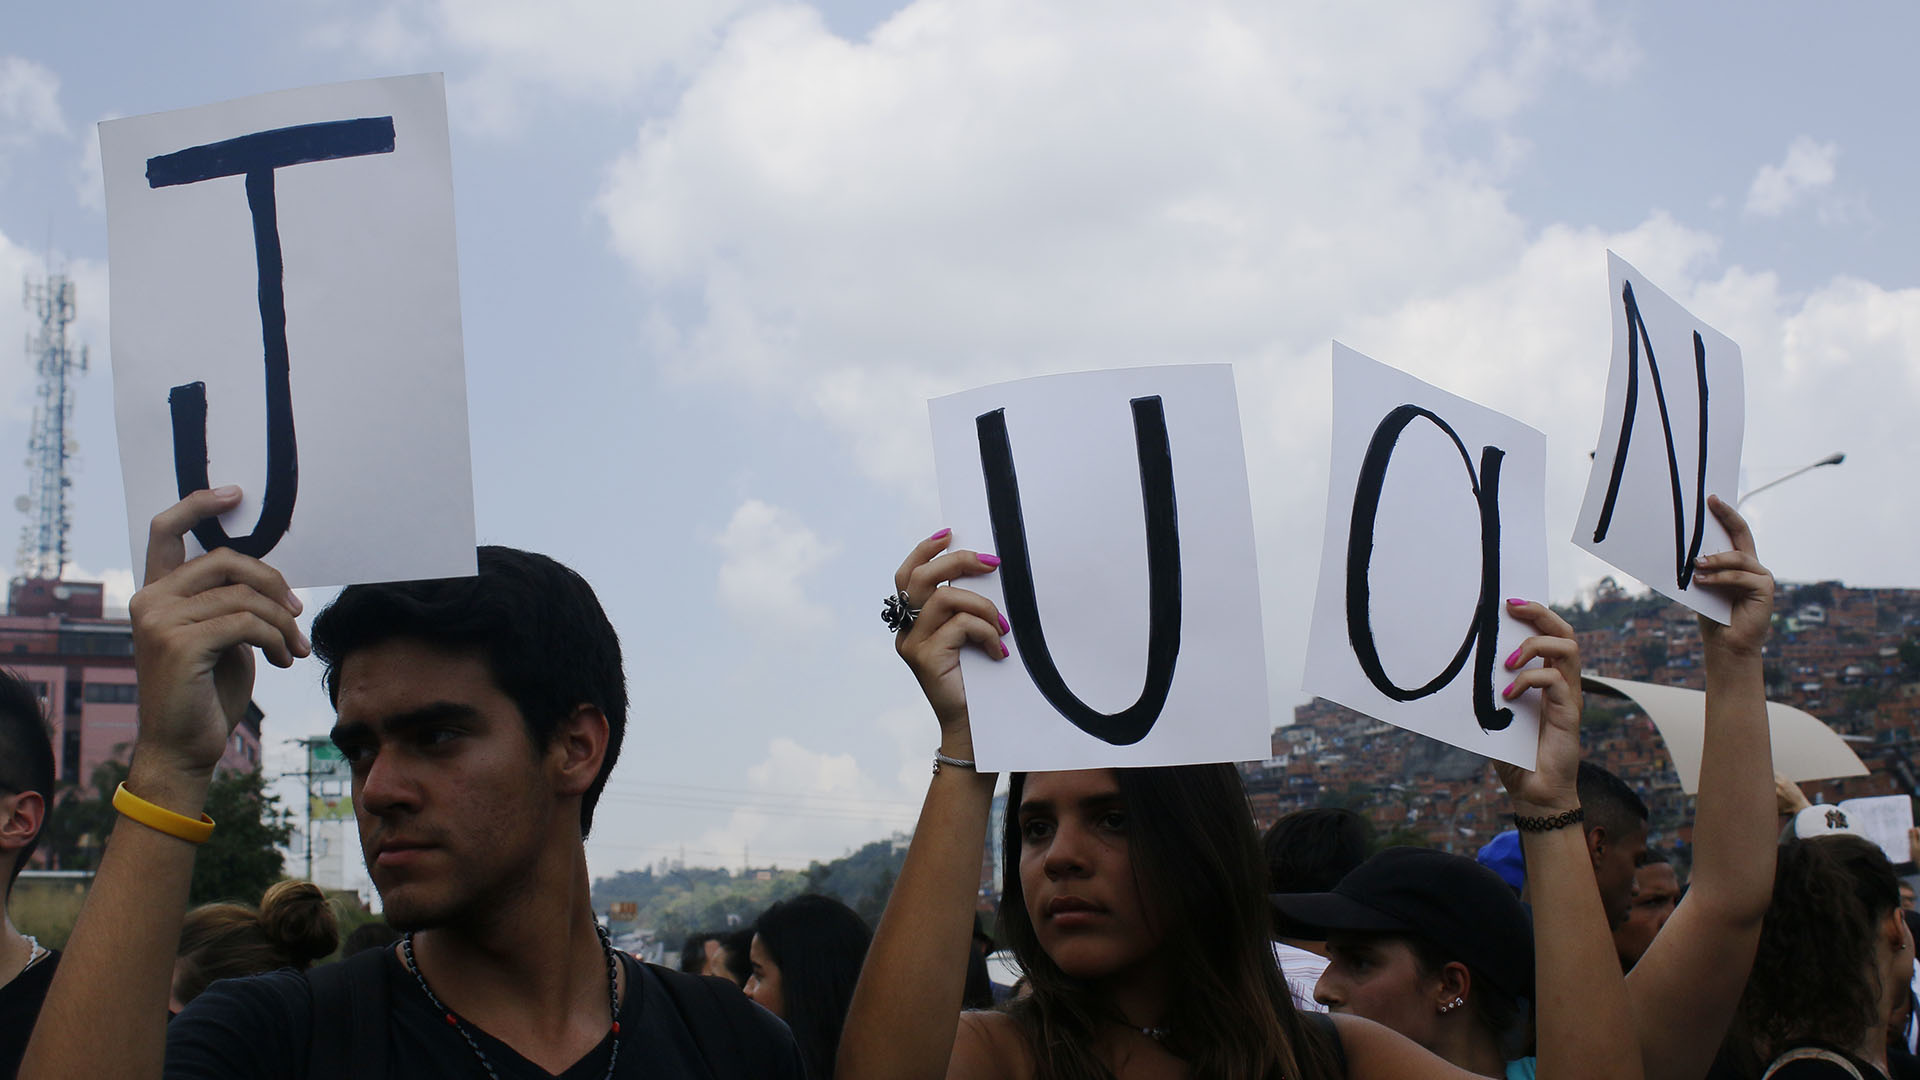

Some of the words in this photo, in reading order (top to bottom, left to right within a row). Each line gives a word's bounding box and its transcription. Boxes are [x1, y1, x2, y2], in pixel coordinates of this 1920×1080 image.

[146, 116, 396, 560] J
[1593, 279, 1709, 591] N
[976, 395, 1181, 746] U
